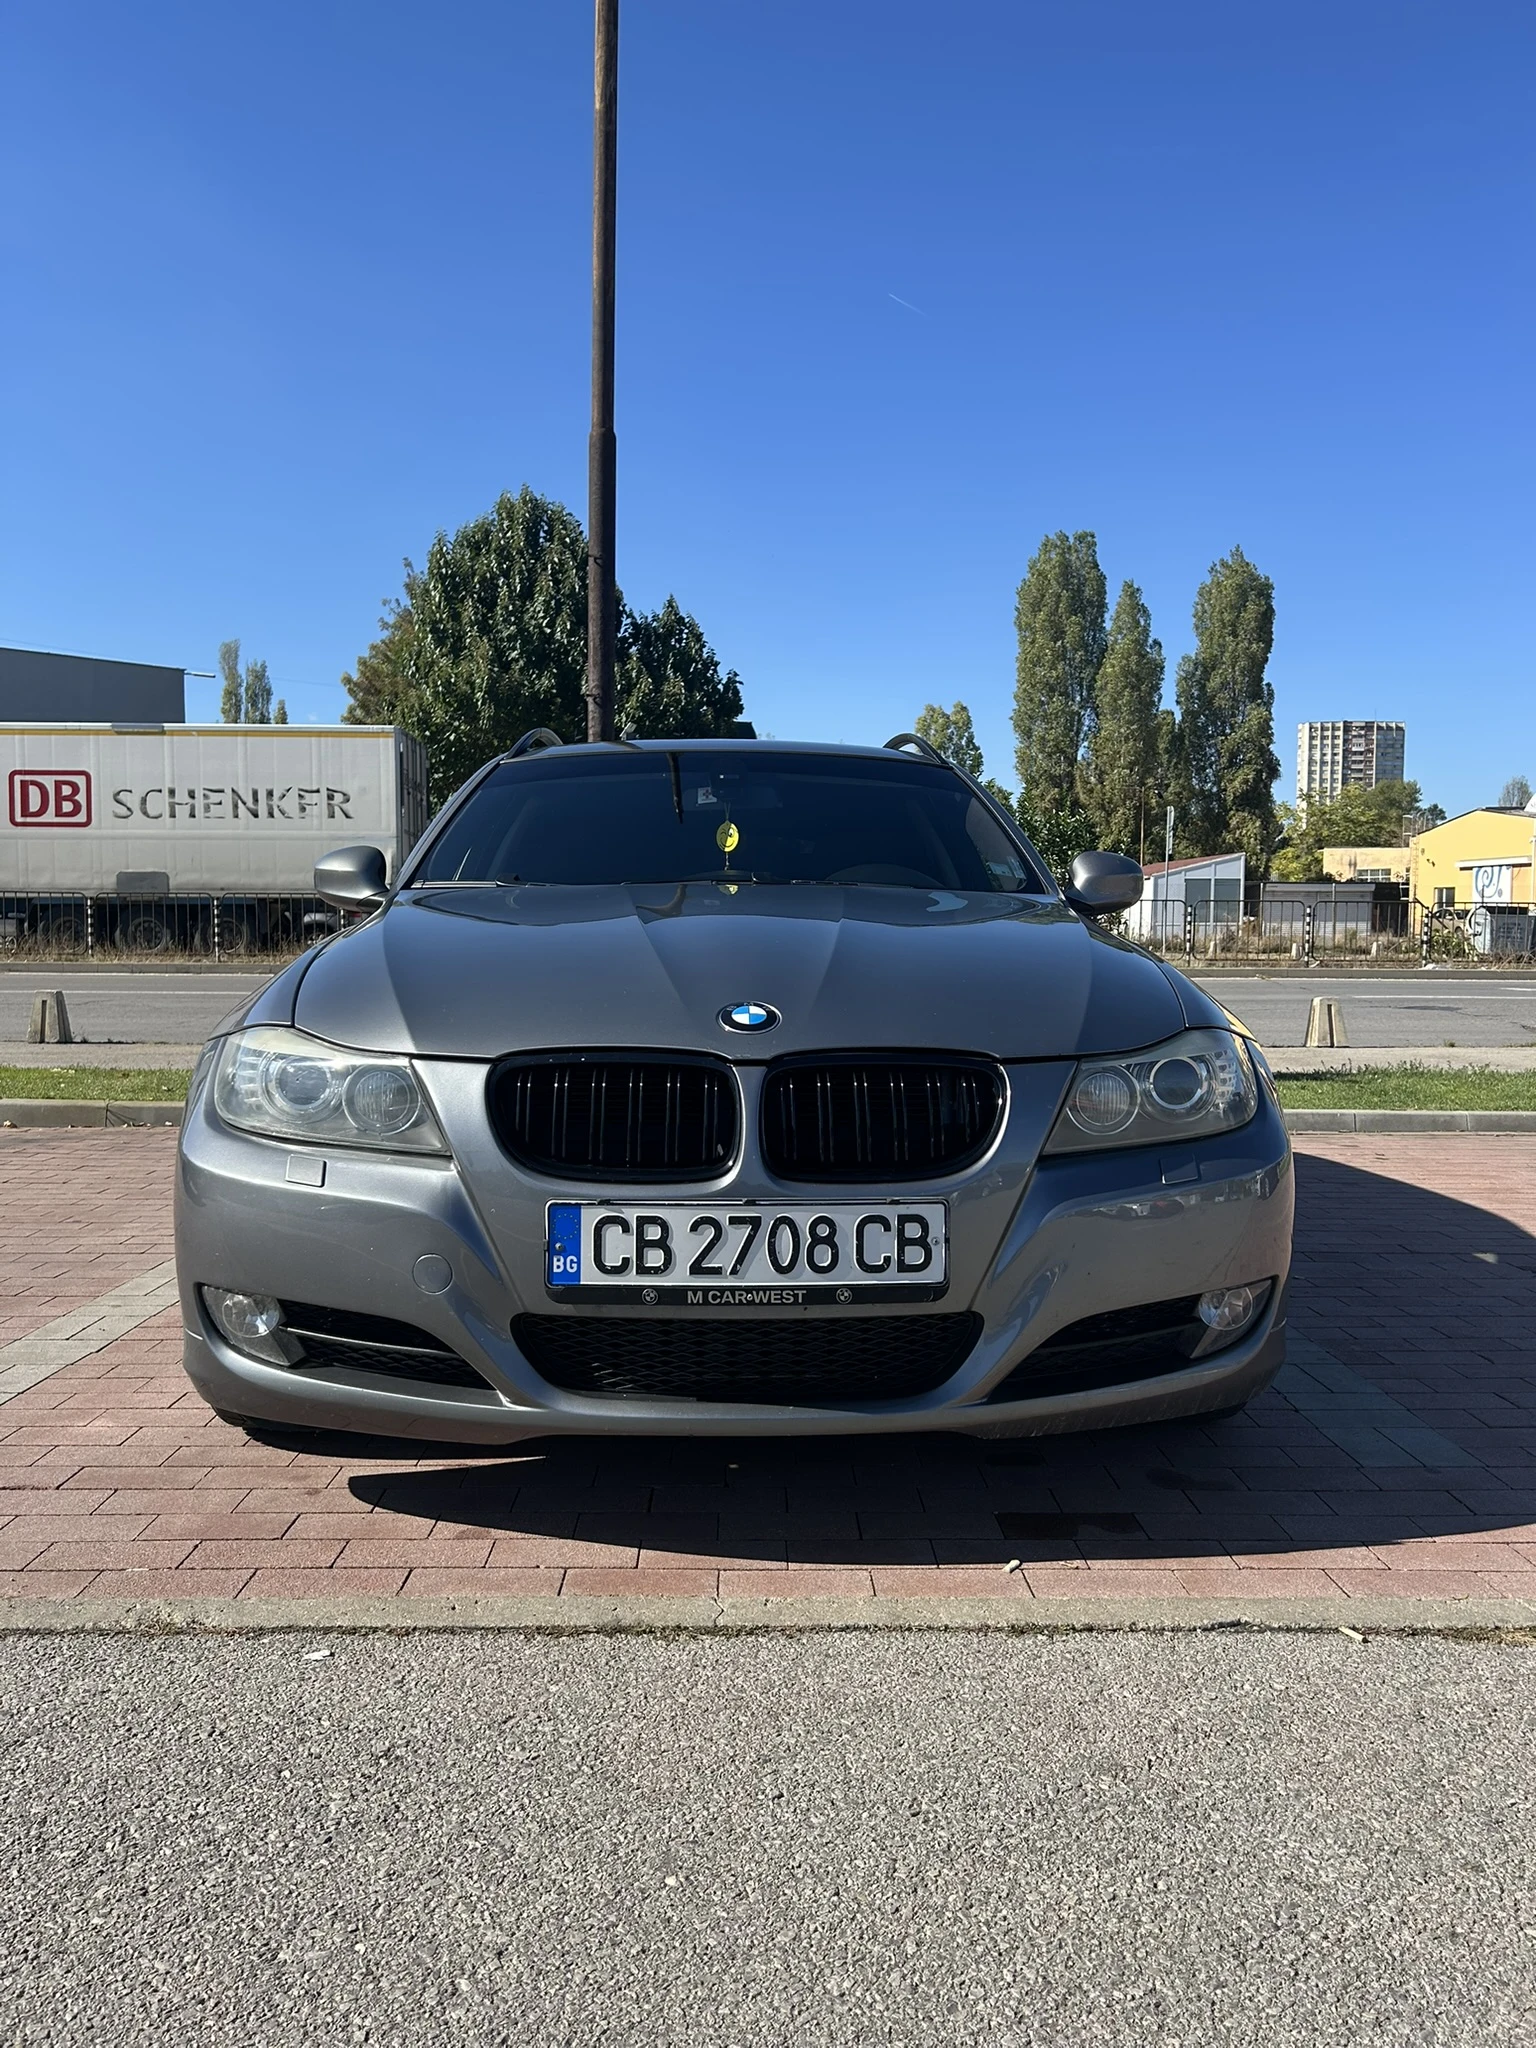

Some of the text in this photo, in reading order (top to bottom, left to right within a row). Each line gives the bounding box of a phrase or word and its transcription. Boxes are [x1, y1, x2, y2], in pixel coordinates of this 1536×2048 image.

[19, 779, 83, 818] DB
[593, 1213, 933, 1276] CB 2708 CB
[553, 1255, 578, 1273] BG
[687, 1290, 807, 1304] M CAR WEST
